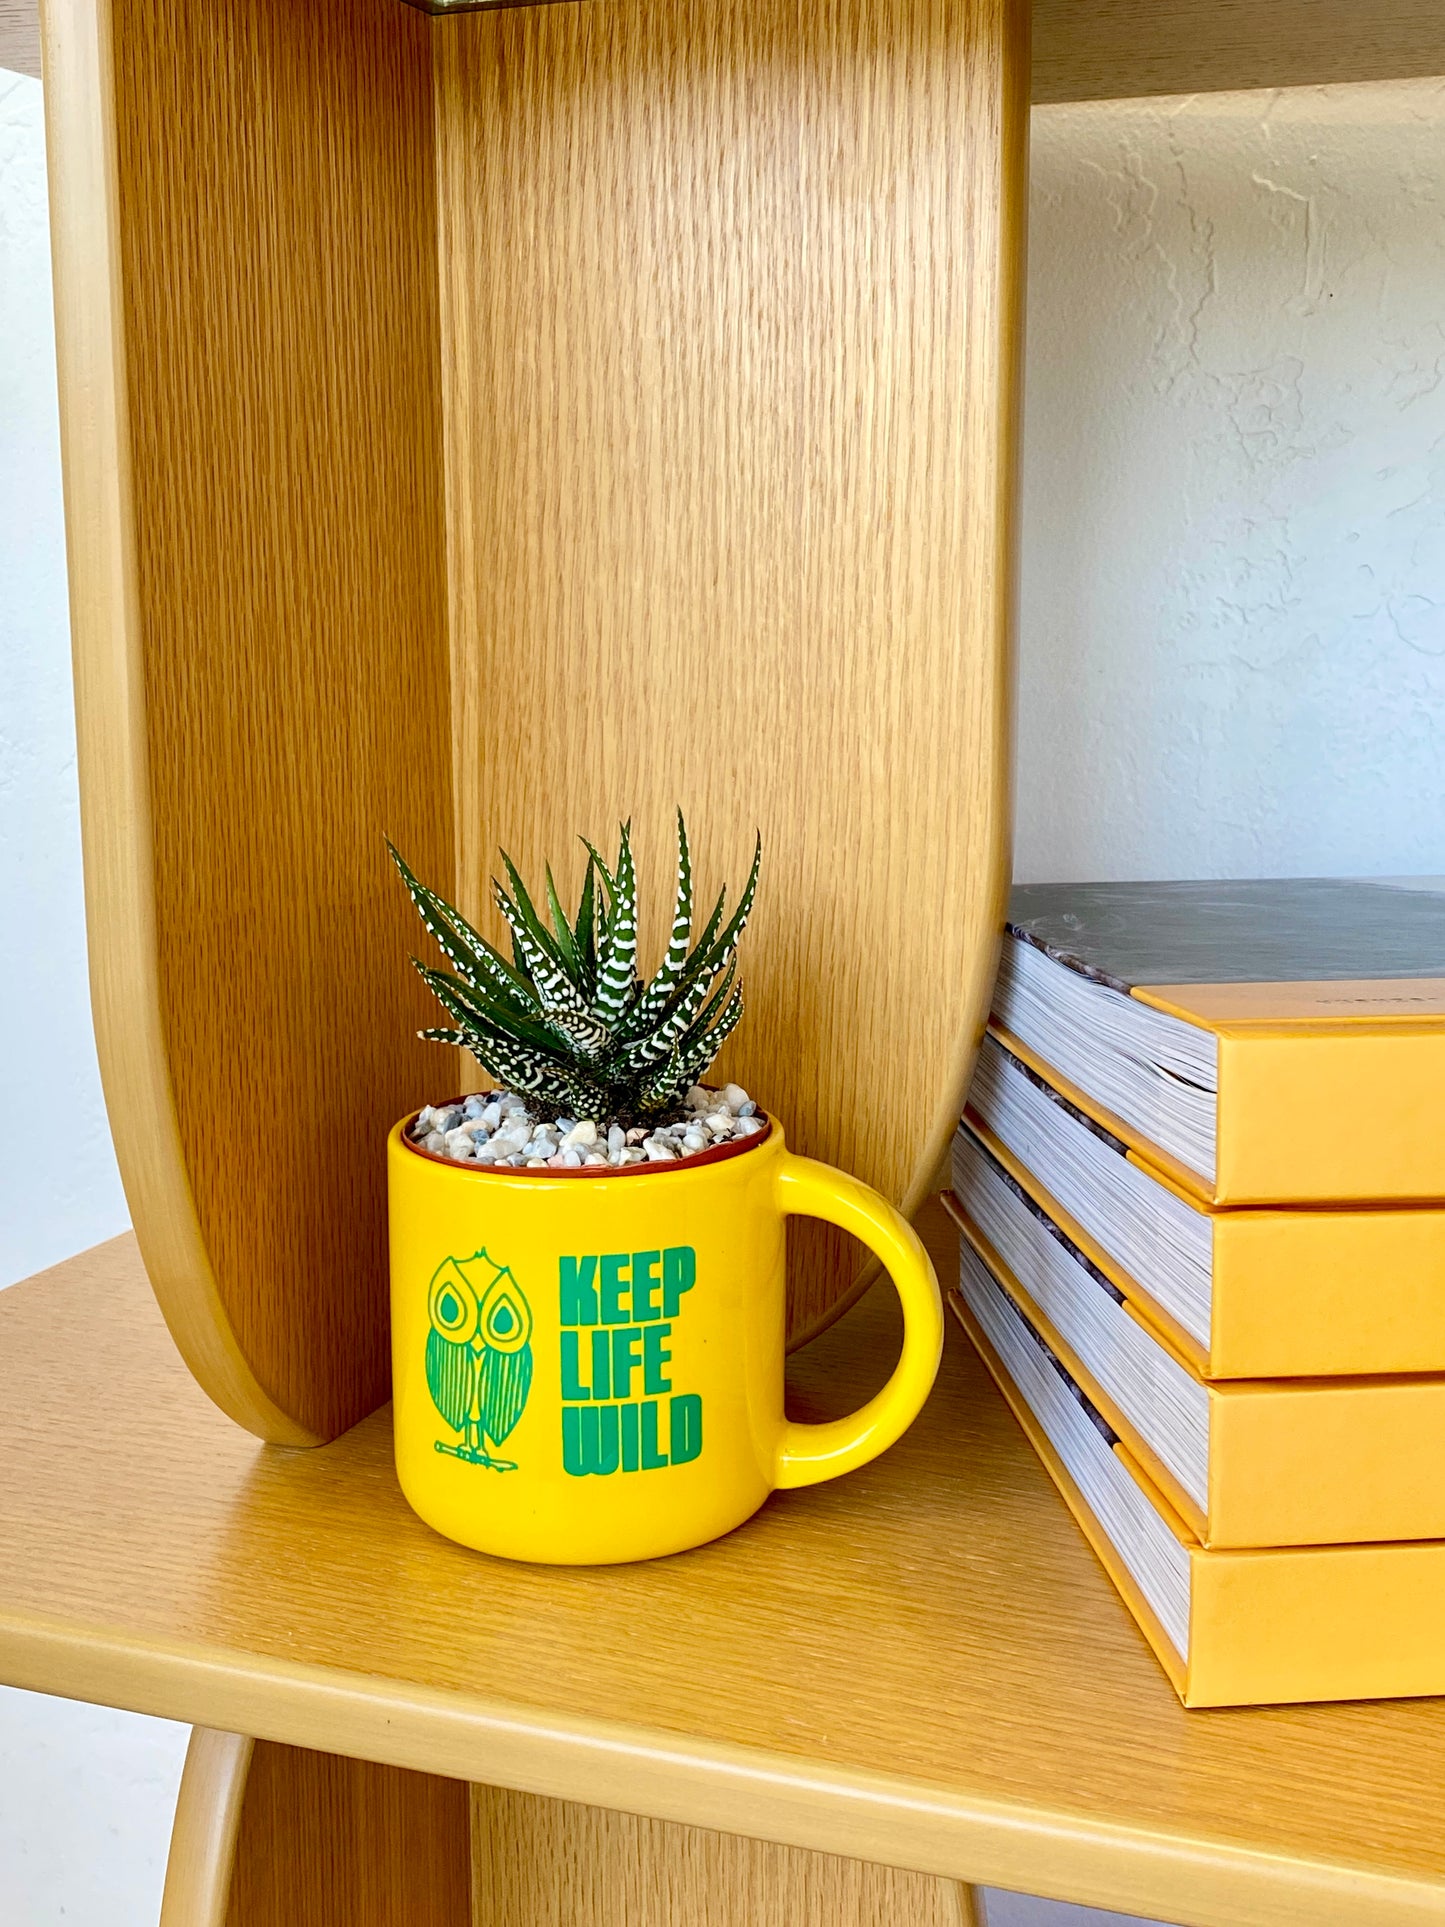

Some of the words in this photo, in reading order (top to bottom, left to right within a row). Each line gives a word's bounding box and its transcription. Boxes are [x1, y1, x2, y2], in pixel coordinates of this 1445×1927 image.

[559, 1246, 696, 1327] KEEP
[560, 1323, 672, 1401] LIFE
[561, 1394, 703, 1477] WILD
